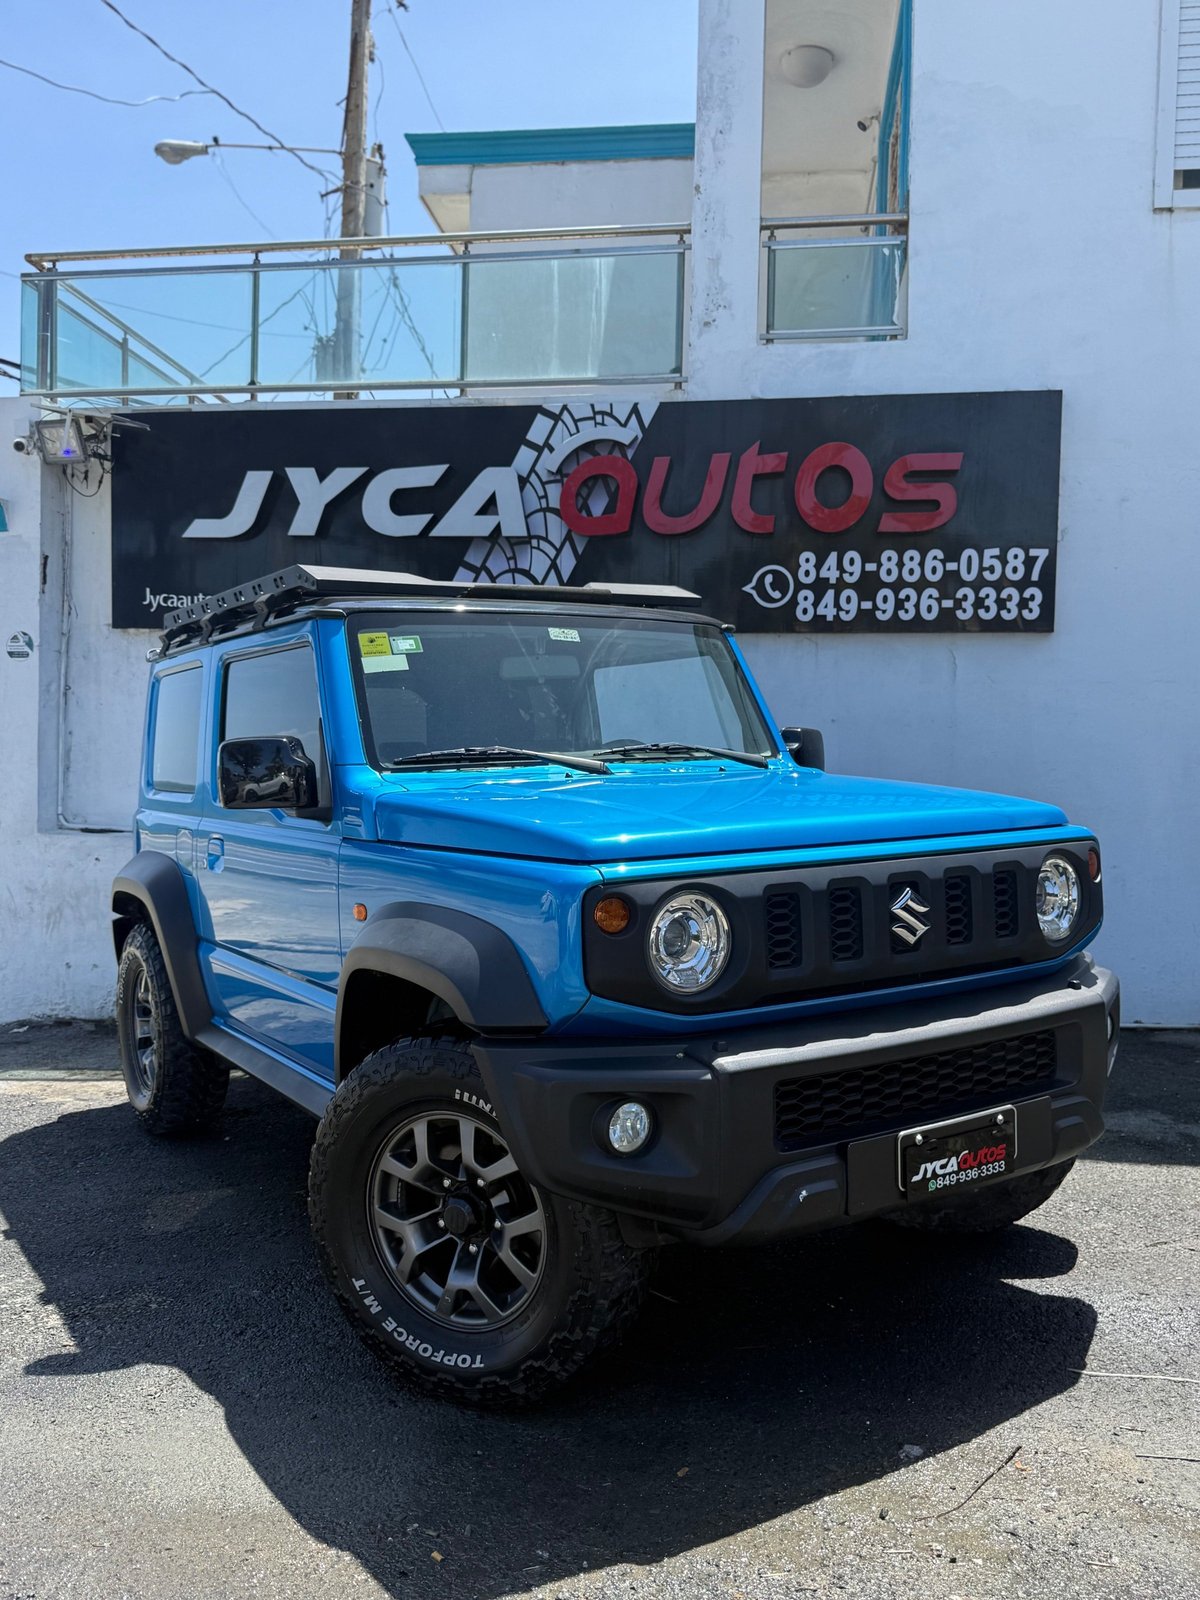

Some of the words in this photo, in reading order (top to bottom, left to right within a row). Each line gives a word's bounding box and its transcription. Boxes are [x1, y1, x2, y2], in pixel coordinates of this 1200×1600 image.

[182, 463, 528, 539] JYCA
[797, 547, 1050, 584] 849-886-0587
[795, 586, 1044, 623] 849-936-3333
[911, 1156, 959, 1182] JYCA
[936, 1160, 1006, 1189] 849-936-3333
[351, 1277, 383, 1315] M/T
[381, 1316, 485, 1369] TOPFORCE
